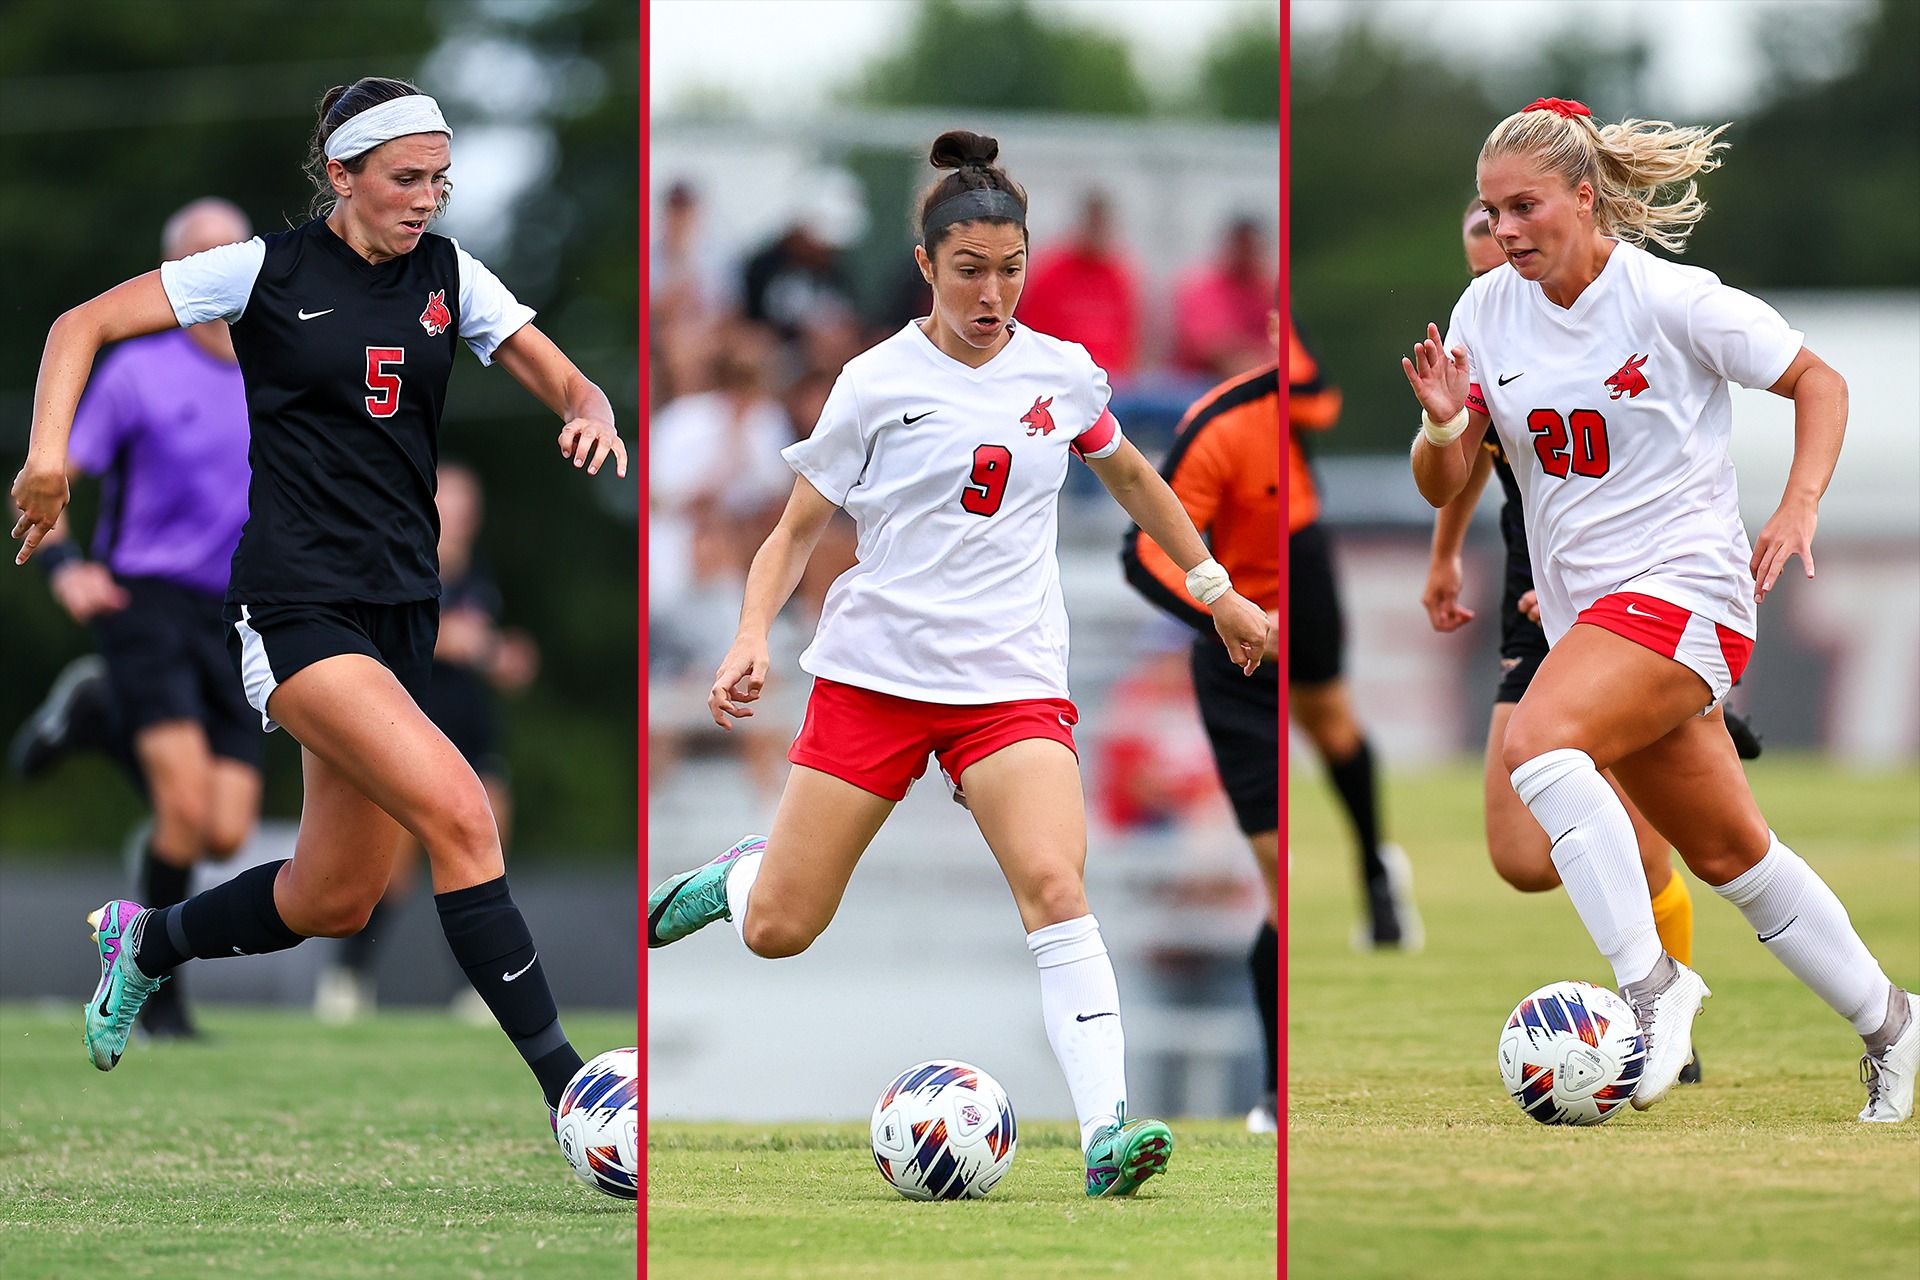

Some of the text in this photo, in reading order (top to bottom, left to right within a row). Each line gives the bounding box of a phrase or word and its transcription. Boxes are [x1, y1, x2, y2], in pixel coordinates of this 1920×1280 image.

[365, 346, 404, 418] 5
[1526, 407, 1610, 480] 20
[960, 444, 1012, 518] 9
